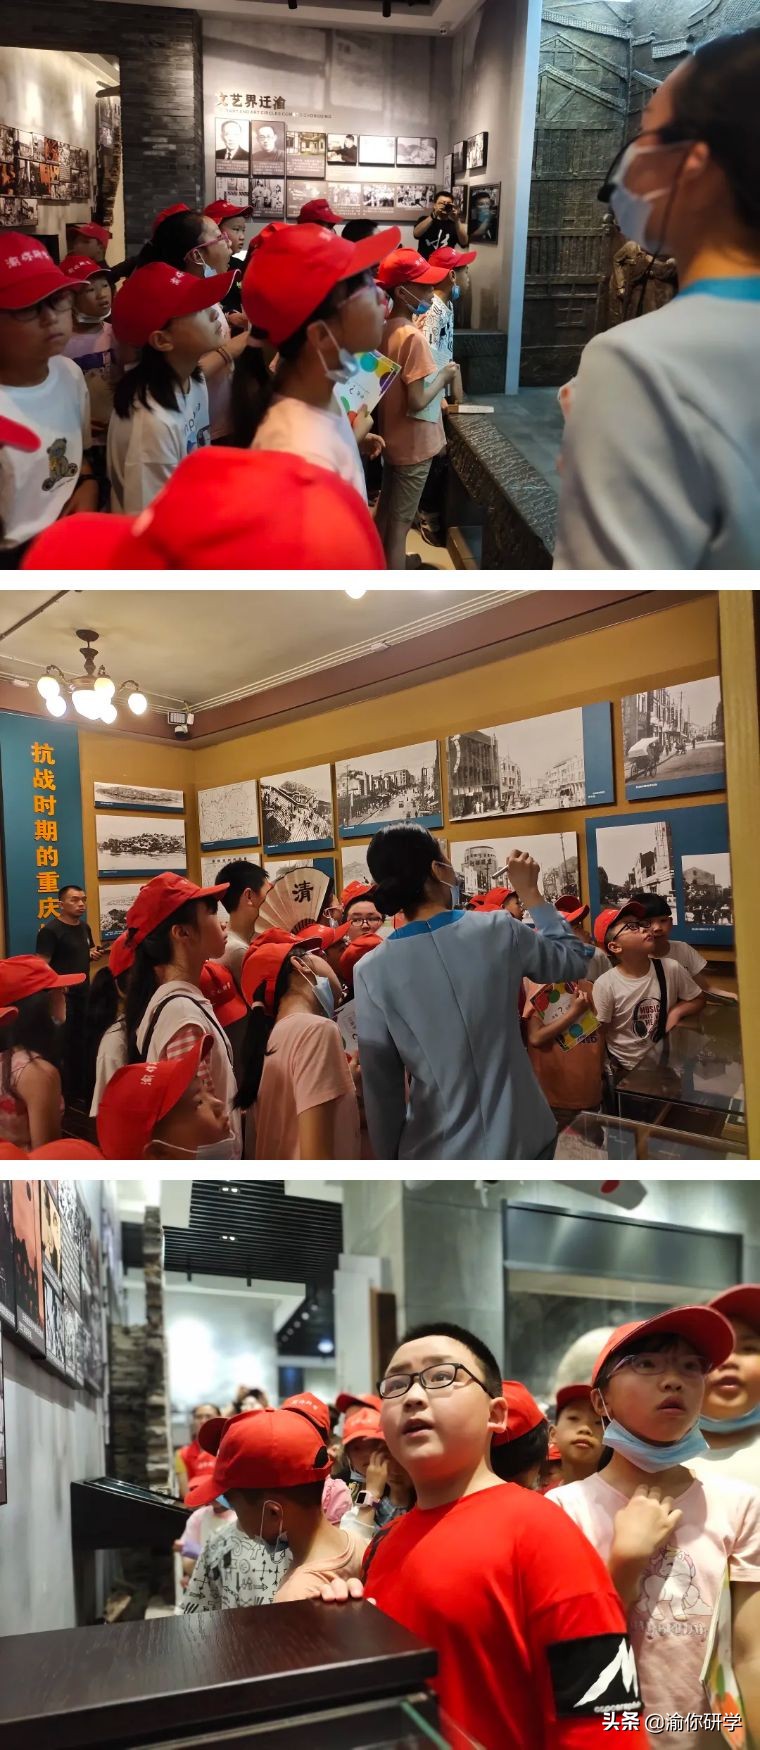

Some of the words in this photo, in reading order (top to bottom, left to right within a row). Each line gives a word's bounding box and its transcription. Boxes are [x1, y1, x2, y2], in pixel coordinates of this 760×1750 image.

[217, 91, 287, 110] 文艺界迁渝
[31, 741, 62, 931] 抗战时期的重庆
[292, 880, 314, 903] 清
[640, 1004, 660, 1014] MUSIC
